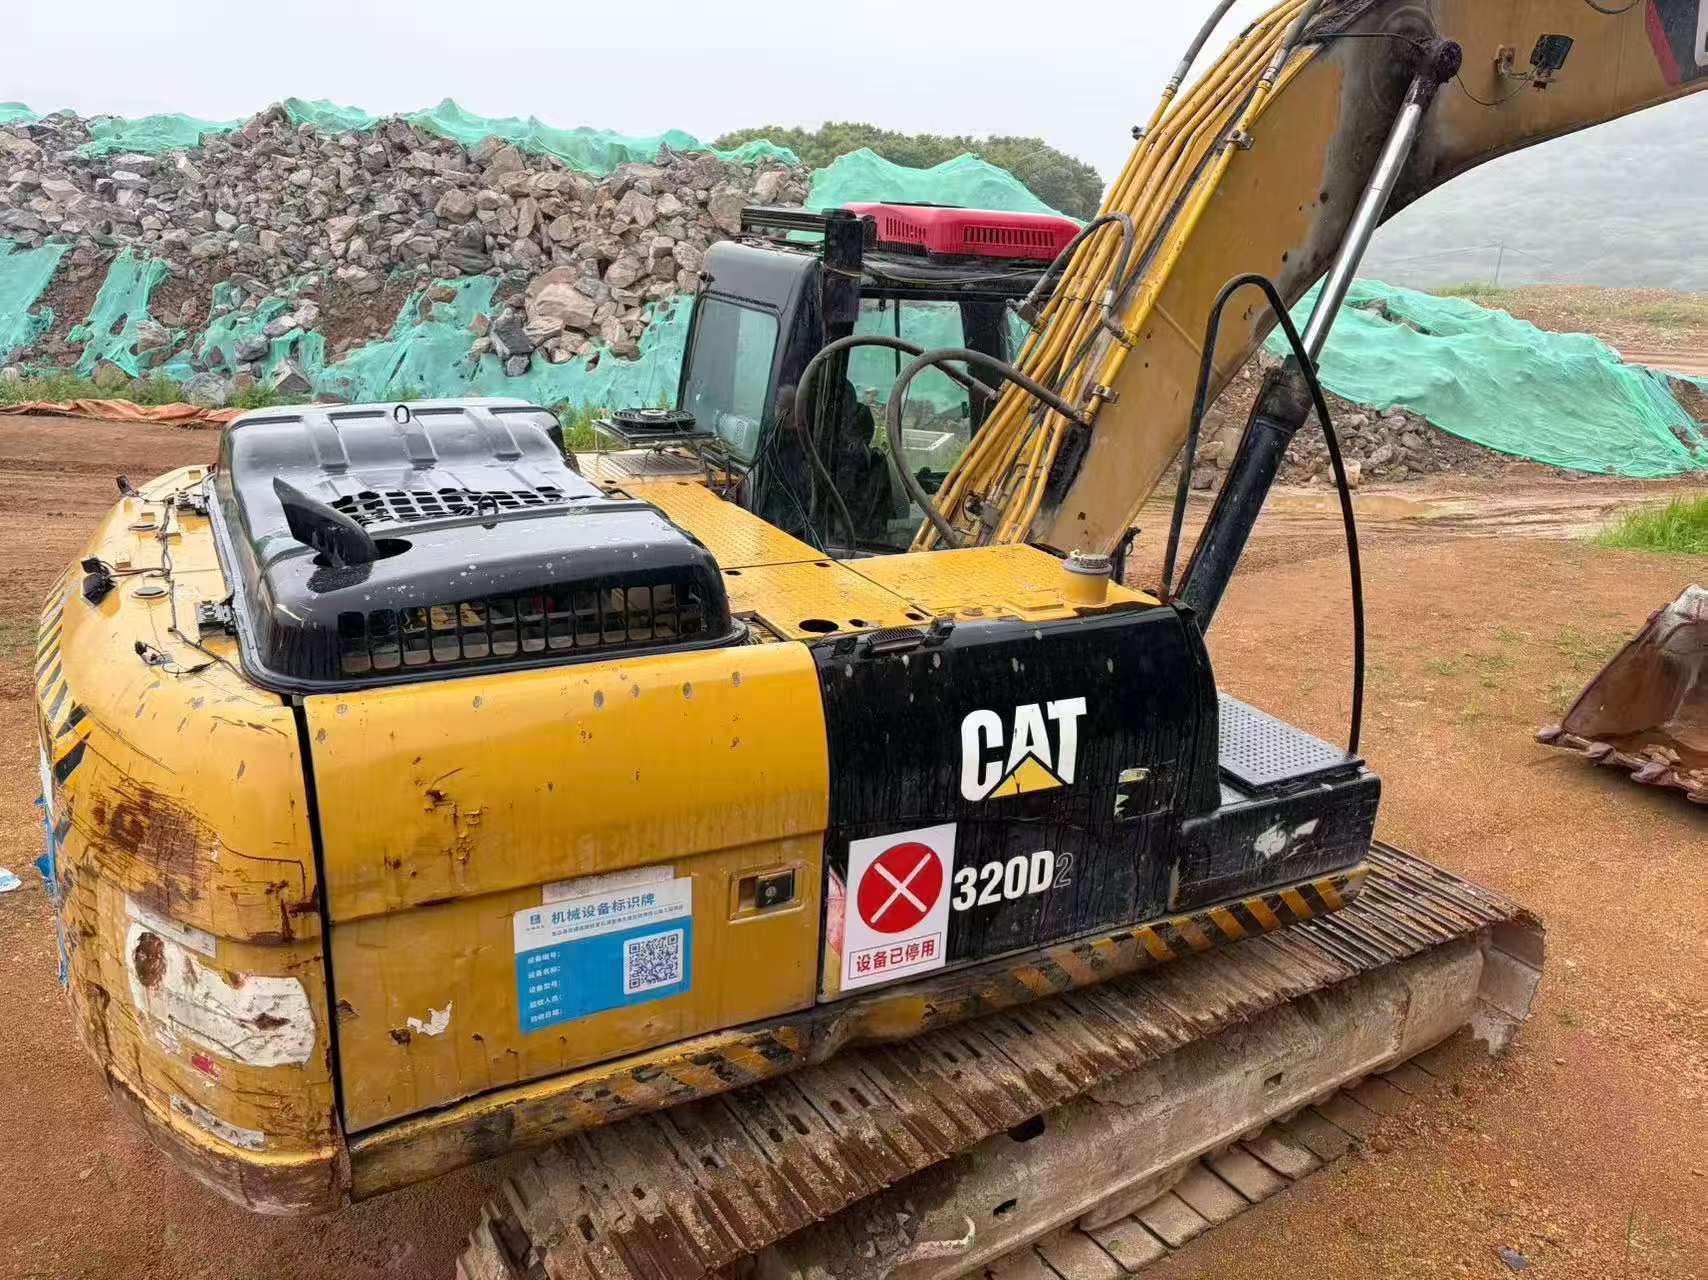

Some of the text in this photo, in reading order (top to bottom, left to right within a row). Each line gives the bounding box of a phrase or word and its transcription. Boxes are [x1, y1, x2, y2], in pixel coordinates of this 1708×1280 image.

[961, 697, 1087, 801] CAT
[551, 893, 656, 924] 机械设备标识牌
[856, 939, 935, 973] 设备已停用
